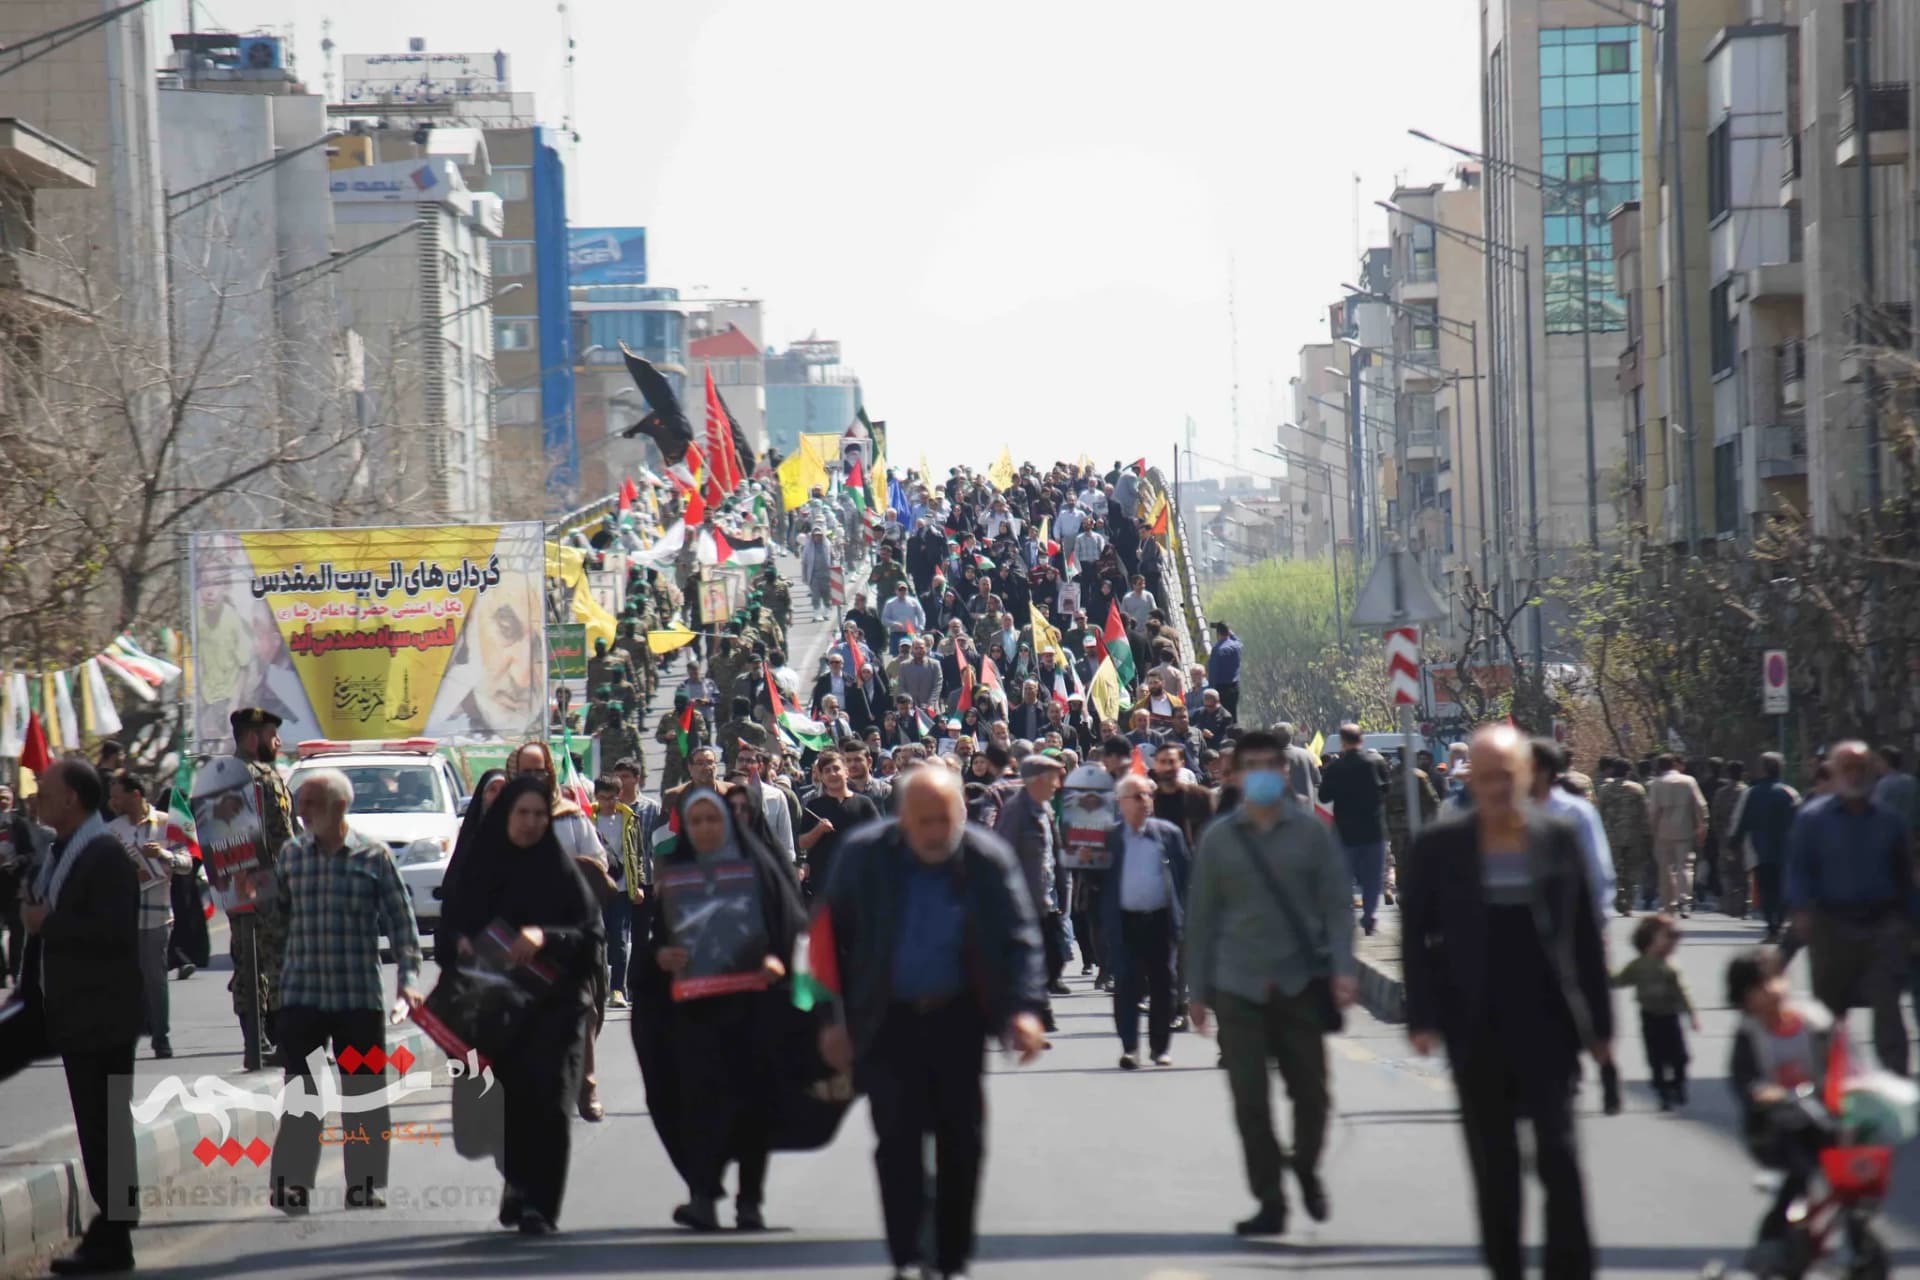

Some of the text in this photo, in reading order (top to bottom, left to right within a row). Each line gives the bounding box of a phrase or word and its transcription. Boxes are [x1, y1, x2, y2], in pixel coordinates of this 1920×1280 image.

[251, 554, 500, 599] گردان های الی بیت المقدس
